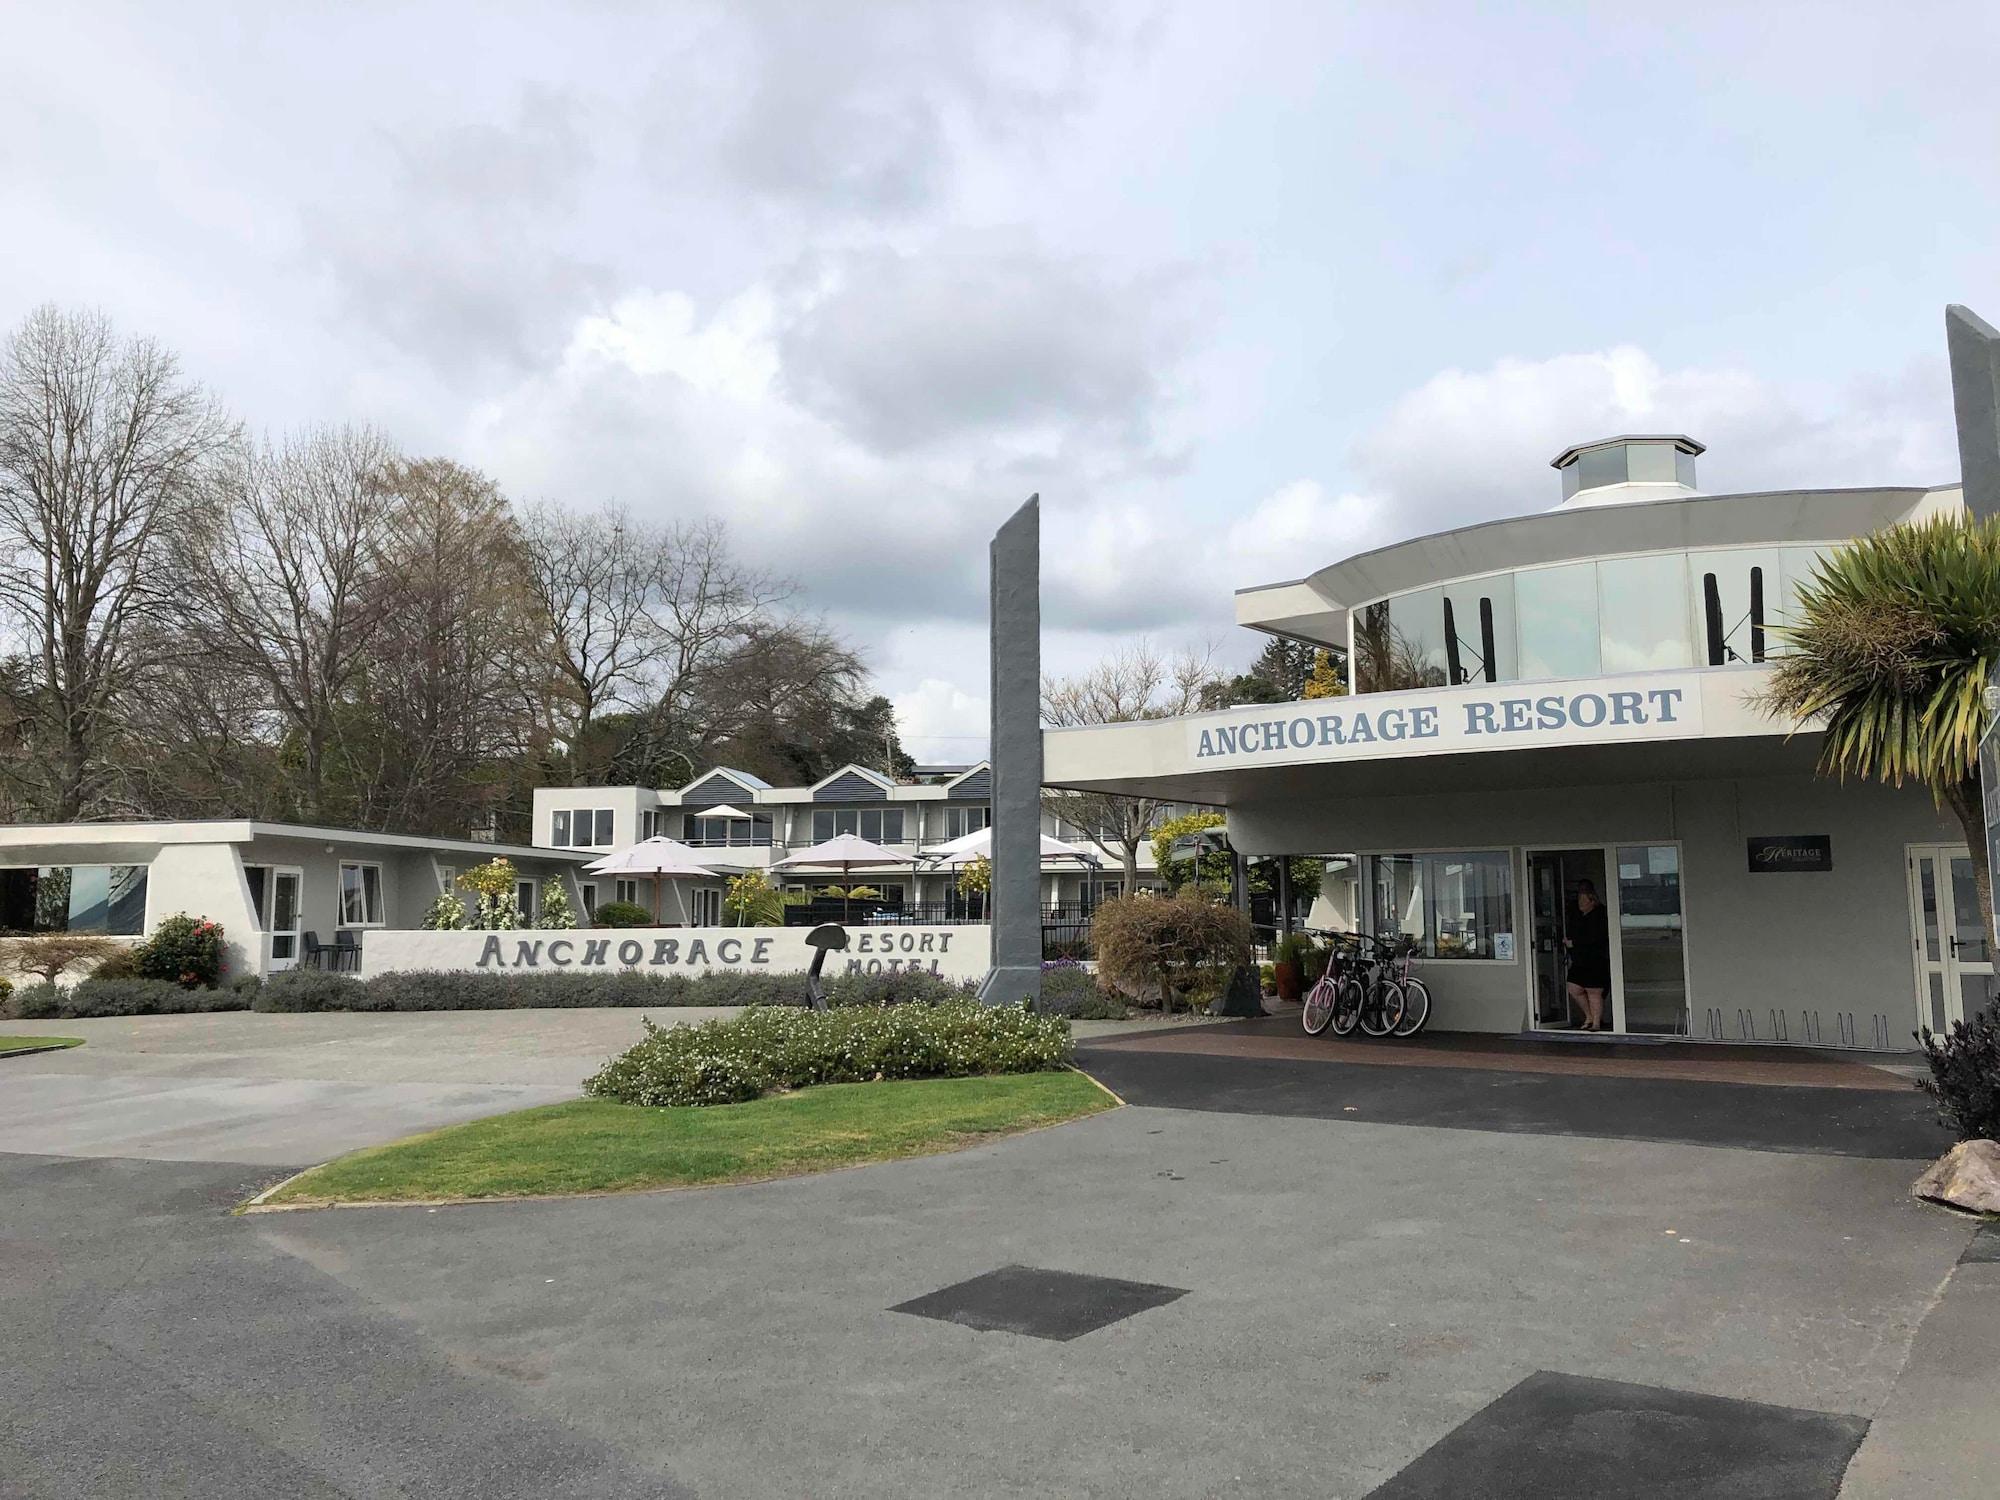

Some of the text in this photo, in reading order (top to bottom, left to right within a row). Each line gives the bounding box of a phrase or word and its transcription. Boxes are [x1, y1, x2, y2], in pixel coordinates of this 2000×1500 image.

[1196, 688, 1682, 758] ANCHORAGE RESORT
[1756, 846, 1822, 862] HERITAGE
[475, 935, 774, 967] ANCHORAGE
